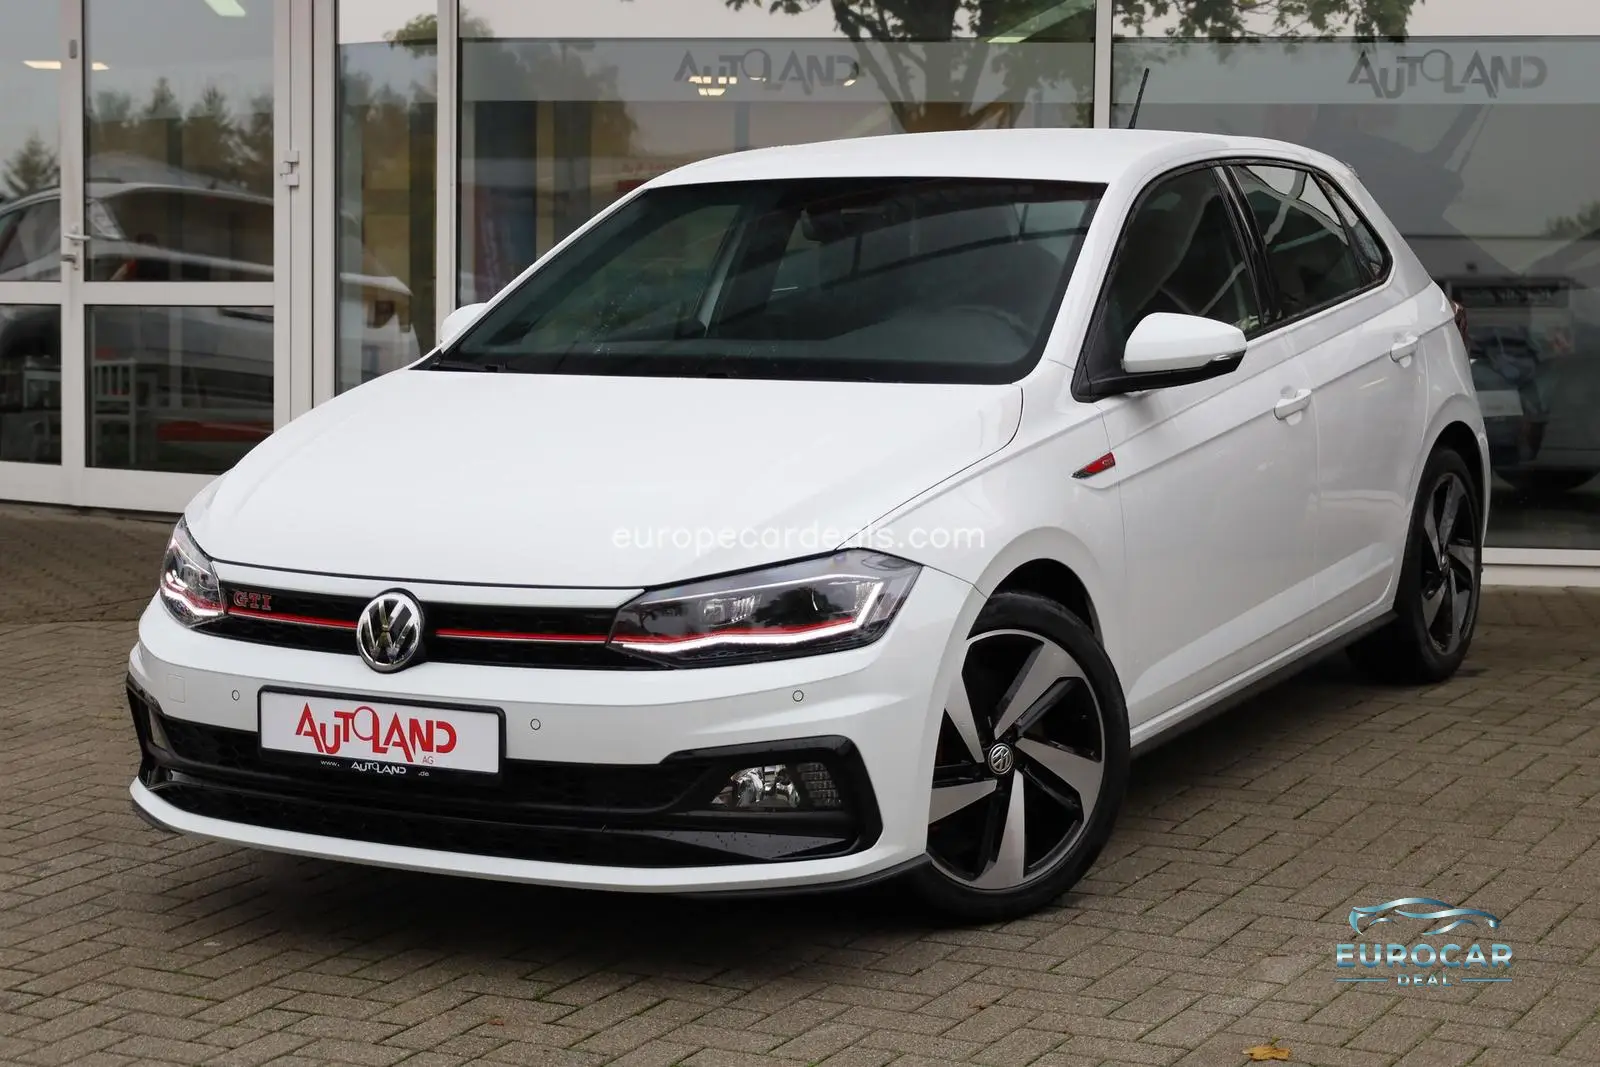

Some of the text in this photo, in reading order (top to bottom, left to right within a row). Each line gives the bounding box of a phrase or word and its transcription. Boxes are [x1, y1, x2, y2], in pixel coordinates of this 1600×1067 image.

[1347, 49, 1548, 98] AUTOLAND
[233, 590, 272, 611] GTI
[295, 702, 458, 763] AUTOLAND
[422, 755, 434, 765] AG
